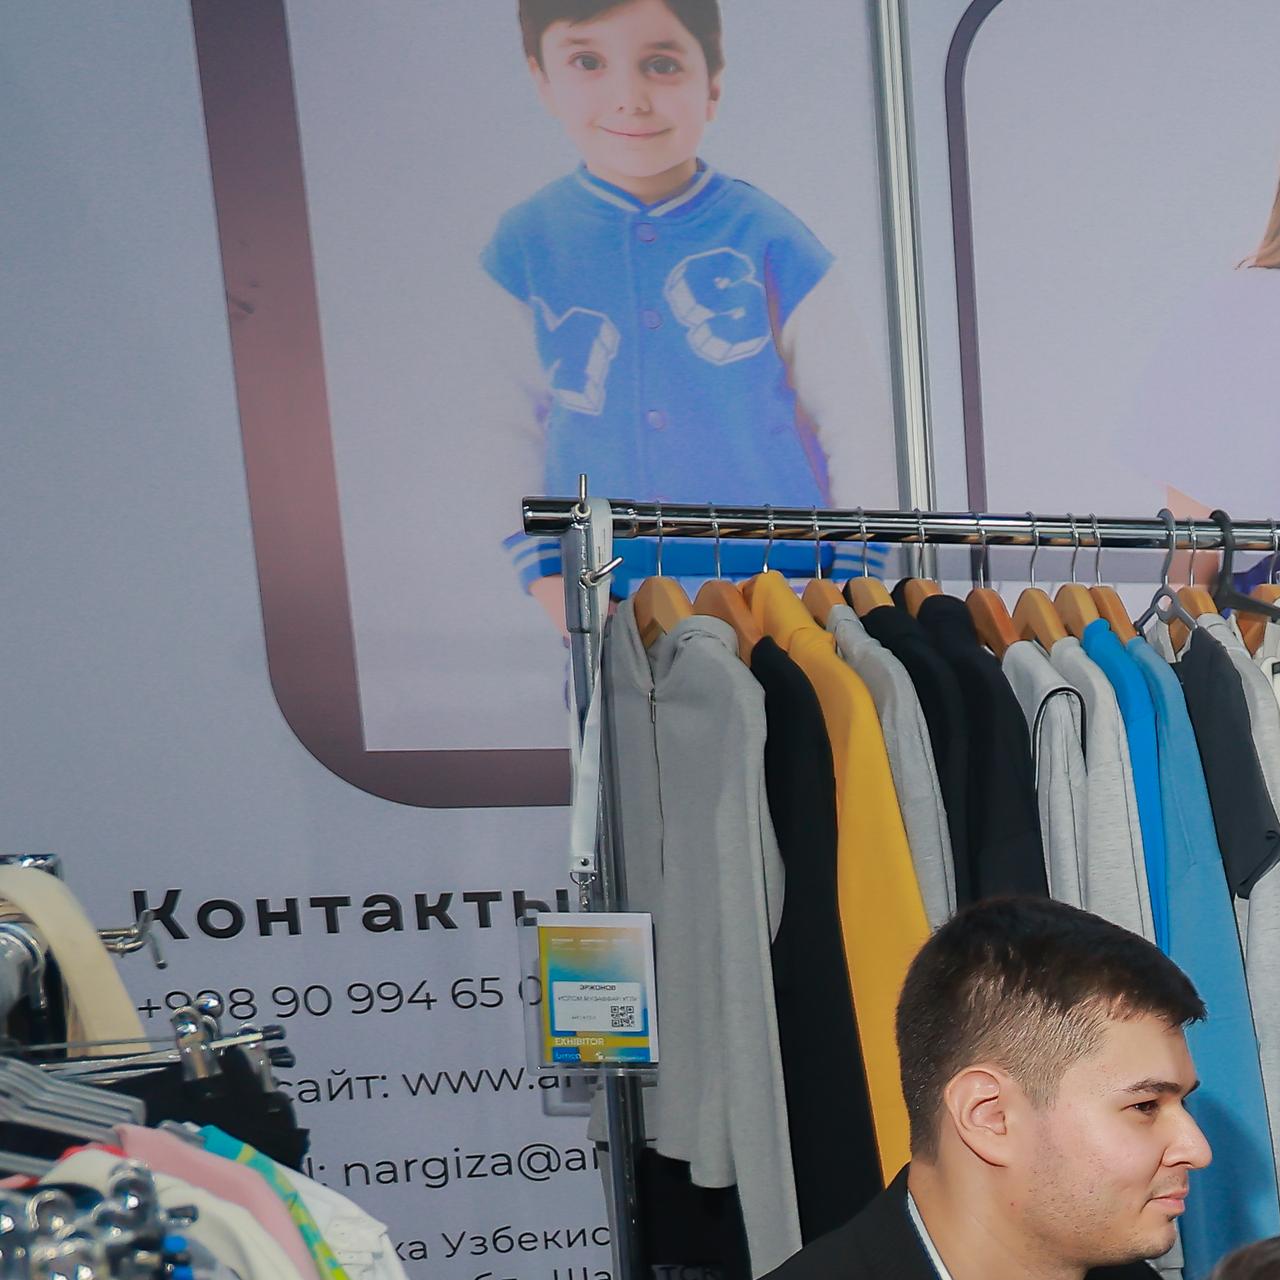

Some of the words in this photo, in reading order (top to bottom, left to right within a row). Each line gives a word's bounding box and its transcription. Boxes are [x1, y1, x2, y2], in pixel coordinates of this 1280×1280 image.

[131, 887, 571, 940] Контакты
[271, 983, 333, 1018] 90
[347, 978, 438, 1016] 994
[450, 976, 505, 1010] 65
